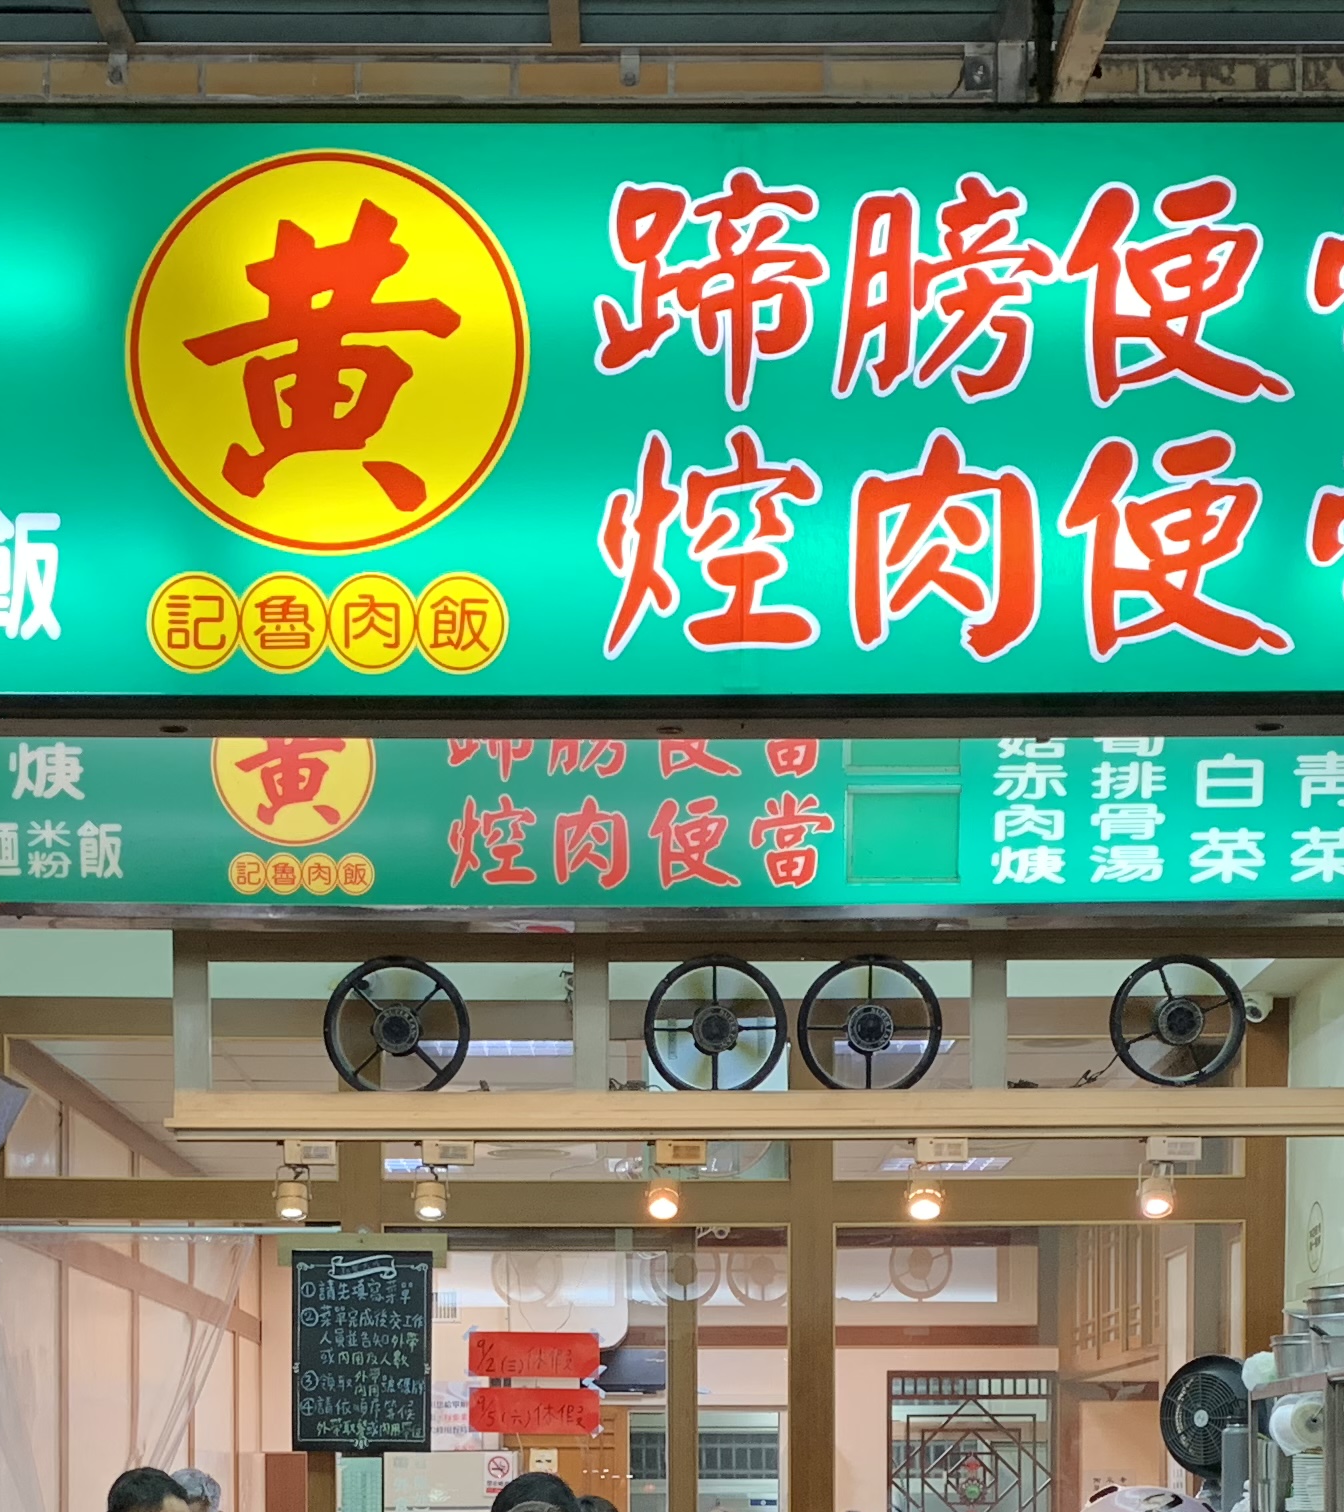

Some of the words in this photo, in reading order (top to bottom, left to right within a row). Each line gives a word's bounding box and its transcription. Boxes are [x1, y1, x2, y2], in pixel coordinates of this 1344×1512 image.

[184, 199, 461, 513] 黃
[162, 588, 496, 658] 記魯肉飯
[235, 738, 346, 826] 黃
[1189, 753, 1267, 884] 白菜
[26, 820, 71, 879] 米粉
[77, 820, 123, 879] 飯
[234, 861, 370, 889] 記魯肉飯
[448, 793, 834, 890] 焢肉便當
